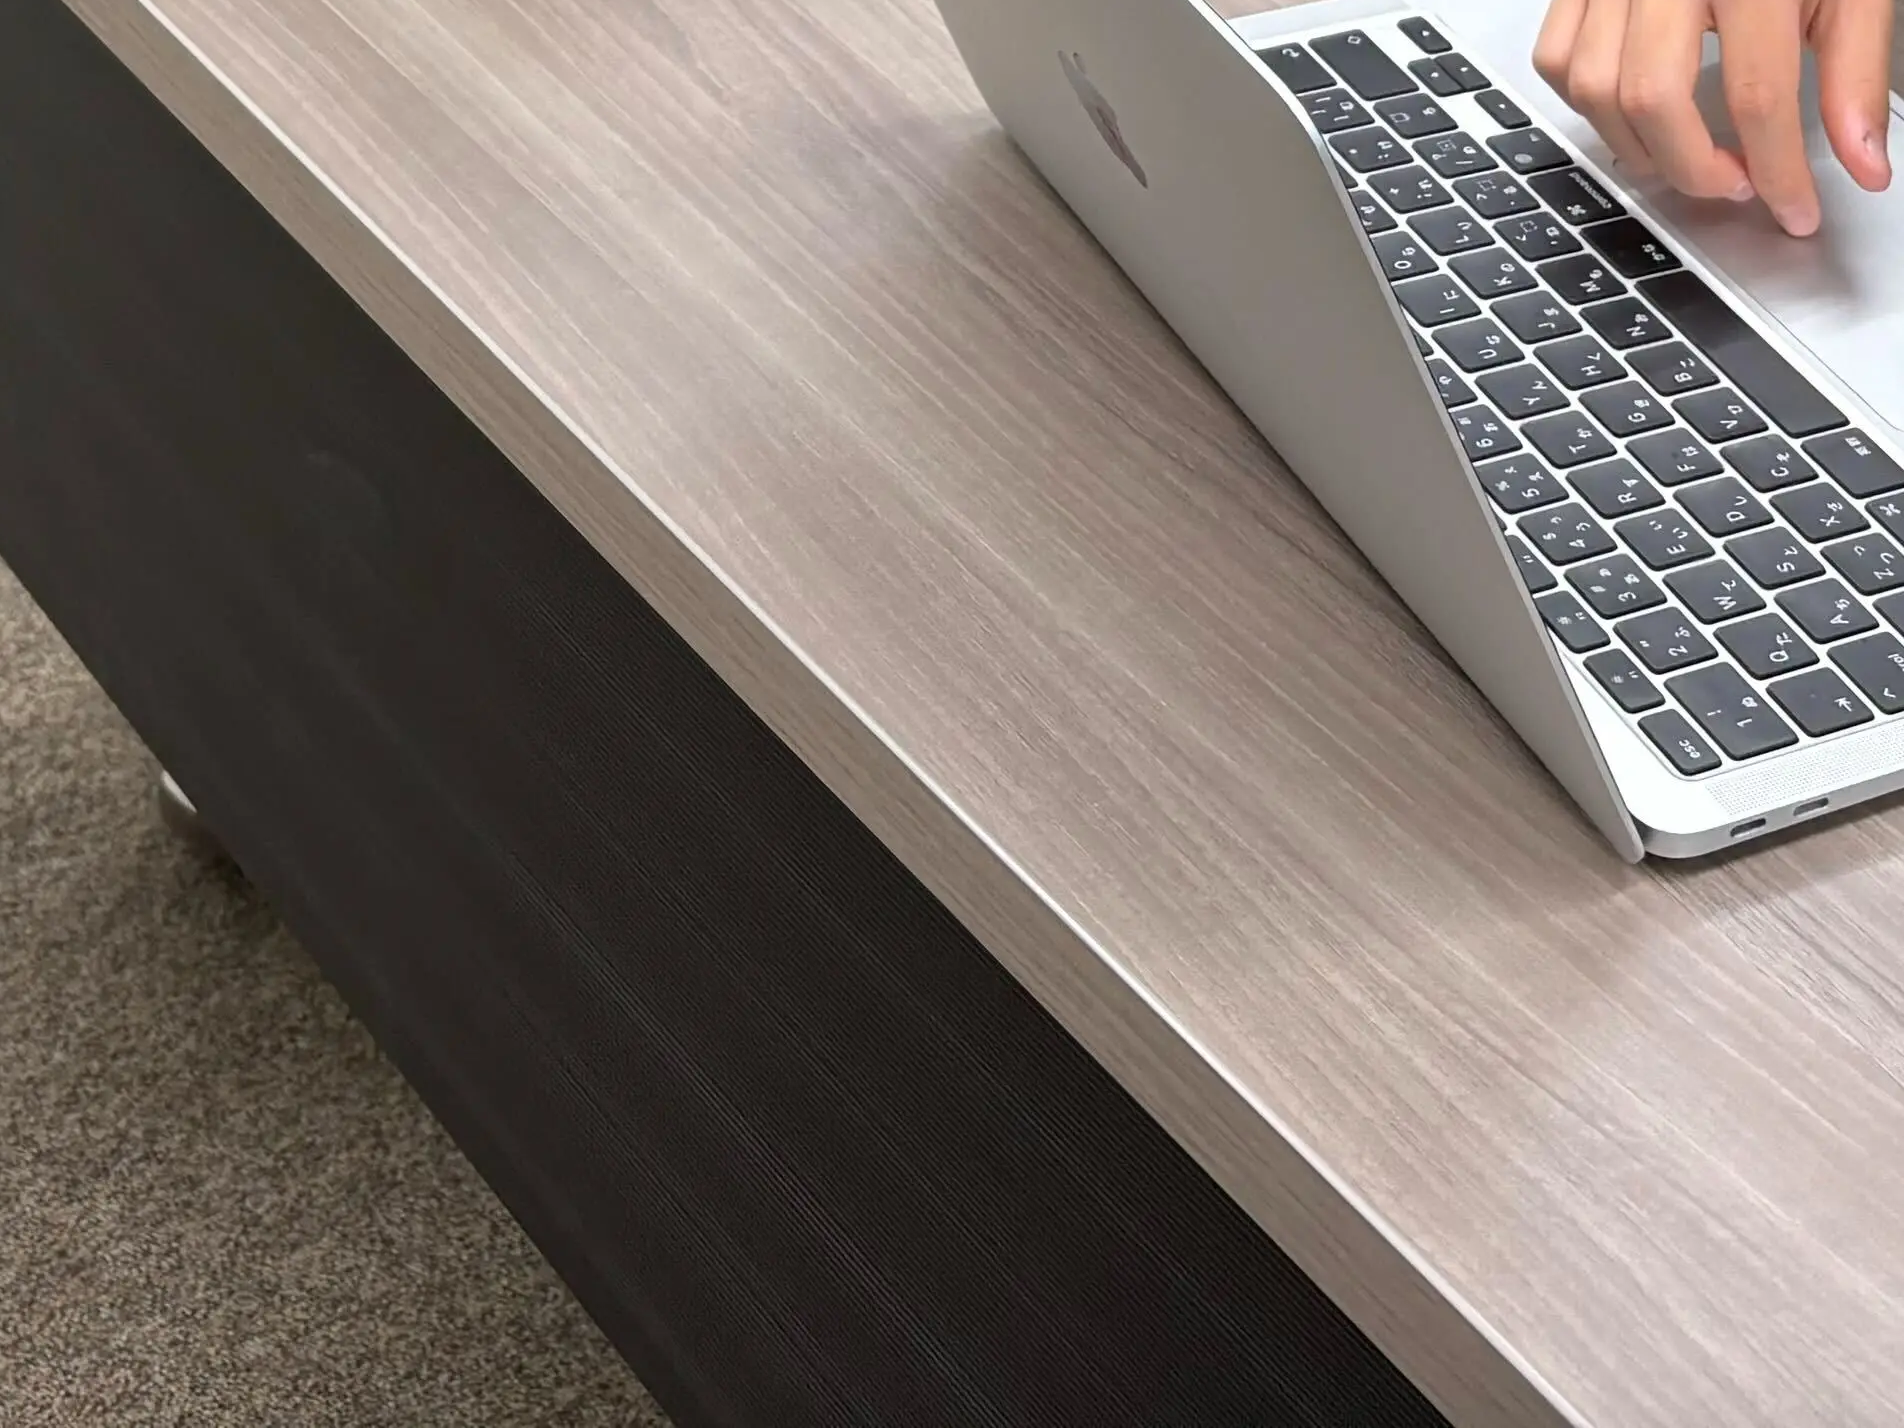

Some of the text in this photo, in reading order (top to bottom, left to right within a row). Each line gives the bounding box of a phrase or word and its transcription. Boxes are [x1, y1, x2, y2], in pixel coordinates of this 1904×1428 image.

[1456, 235, 1469, 243] L
[1394, 261, 1411, 269] O
[1494, 277, 1511, 286] K
[1580, 281, 1600, 292] M
[1627, 326, 1645, 336] N
[1478, 349, 1497, 359] U
[1581, 366, 1601, 375] H
[1675, 373, 1692, 382] B
[1523, 397, 1540, 405] Y
[1628, 413, 1646, 422] G
[1720, 420, 1737, 429] V
[1476, 439, 1493, 447] 6
[1569, 445, 1586, 453] T
[1771, 467, 1789, 476] C
[1522, 489, 1539, 498] 5
[1618, 493, 1636, 503] R
[1726, 512, 1745, 522] D
[1820, 516, 1840, 526] X
[1569, 539, 1585, 547] 4
[1667, 544, 1686, 554] E
[1777, 562, 1795, 572] S
[1874, 568, 1894, 579] Z
[1618, 592, 1636, 601] 3
[1714, 597, 1736, 610] W
[1830, 614, 1849, 624] A
[1669, 646, 1688, 656] 2
[1770, 650, 1789, 662] Q
[1737, 719, 1752, 727] 1
[1679, 740, 1700, 758] esc
